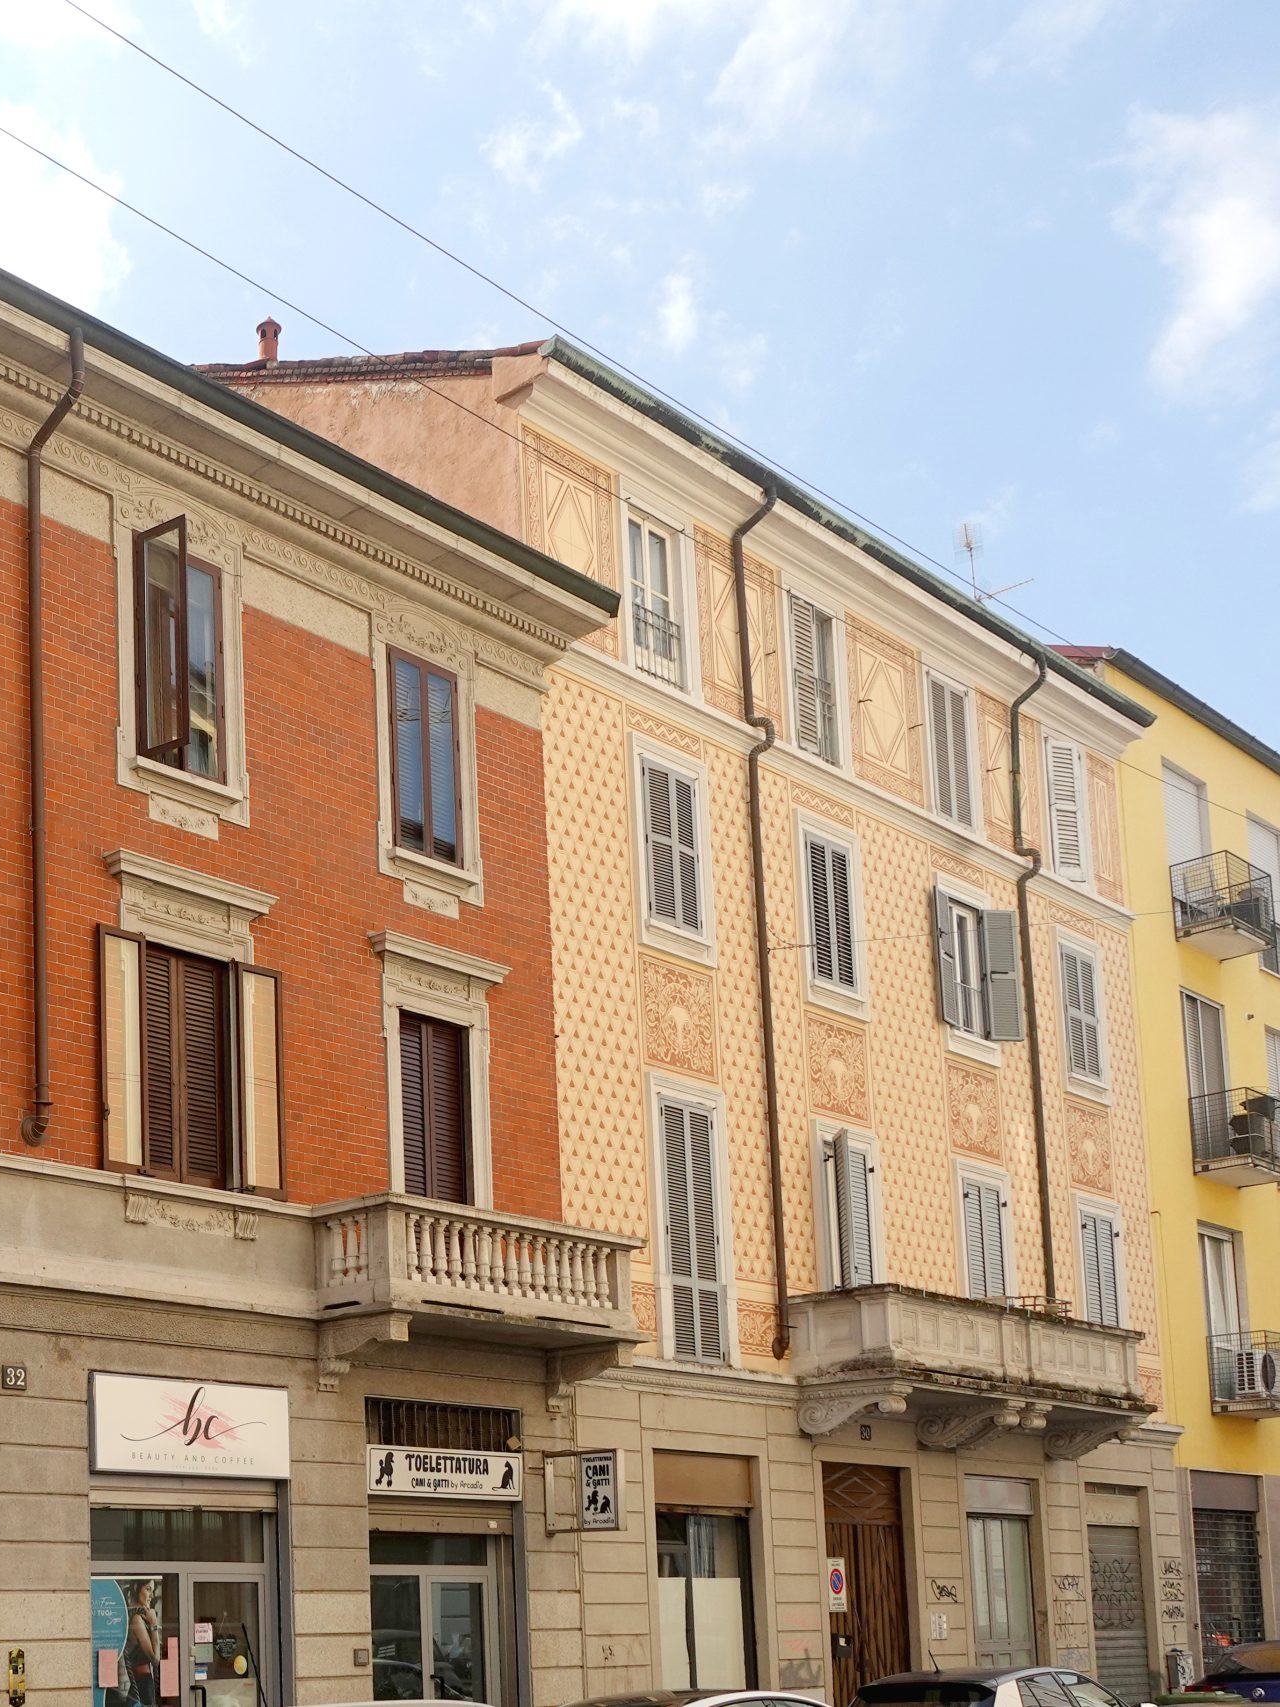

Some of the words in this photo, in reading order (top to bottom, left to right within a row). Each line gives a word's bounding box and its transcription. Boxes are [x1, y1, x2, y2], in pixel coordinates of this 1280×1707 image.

[6, 1367, 25, 1386] 32
[861, 1426, 870, 1439] 30
[131, 1452, 176, 1462] BEAUTY
[184, 1455, 206, 1463] AND
[214, 1456, 255, 1465] COFFEE
[405, 1453, 489, 1476] TOELETTATURA
[585, 1464, 609, 1479] CANI
[411, 1477, 425, 1489] CANI
[426, 1478, 432, 1488] &
[433, 1478, 449, 1491] GATTI
[450, 1481, 458, 1490] by
[459, 1480, 483, 1490] Arcadia
[585, 1480, 591, 1488] &
[592, 1478, 610, 1489] GATTI
